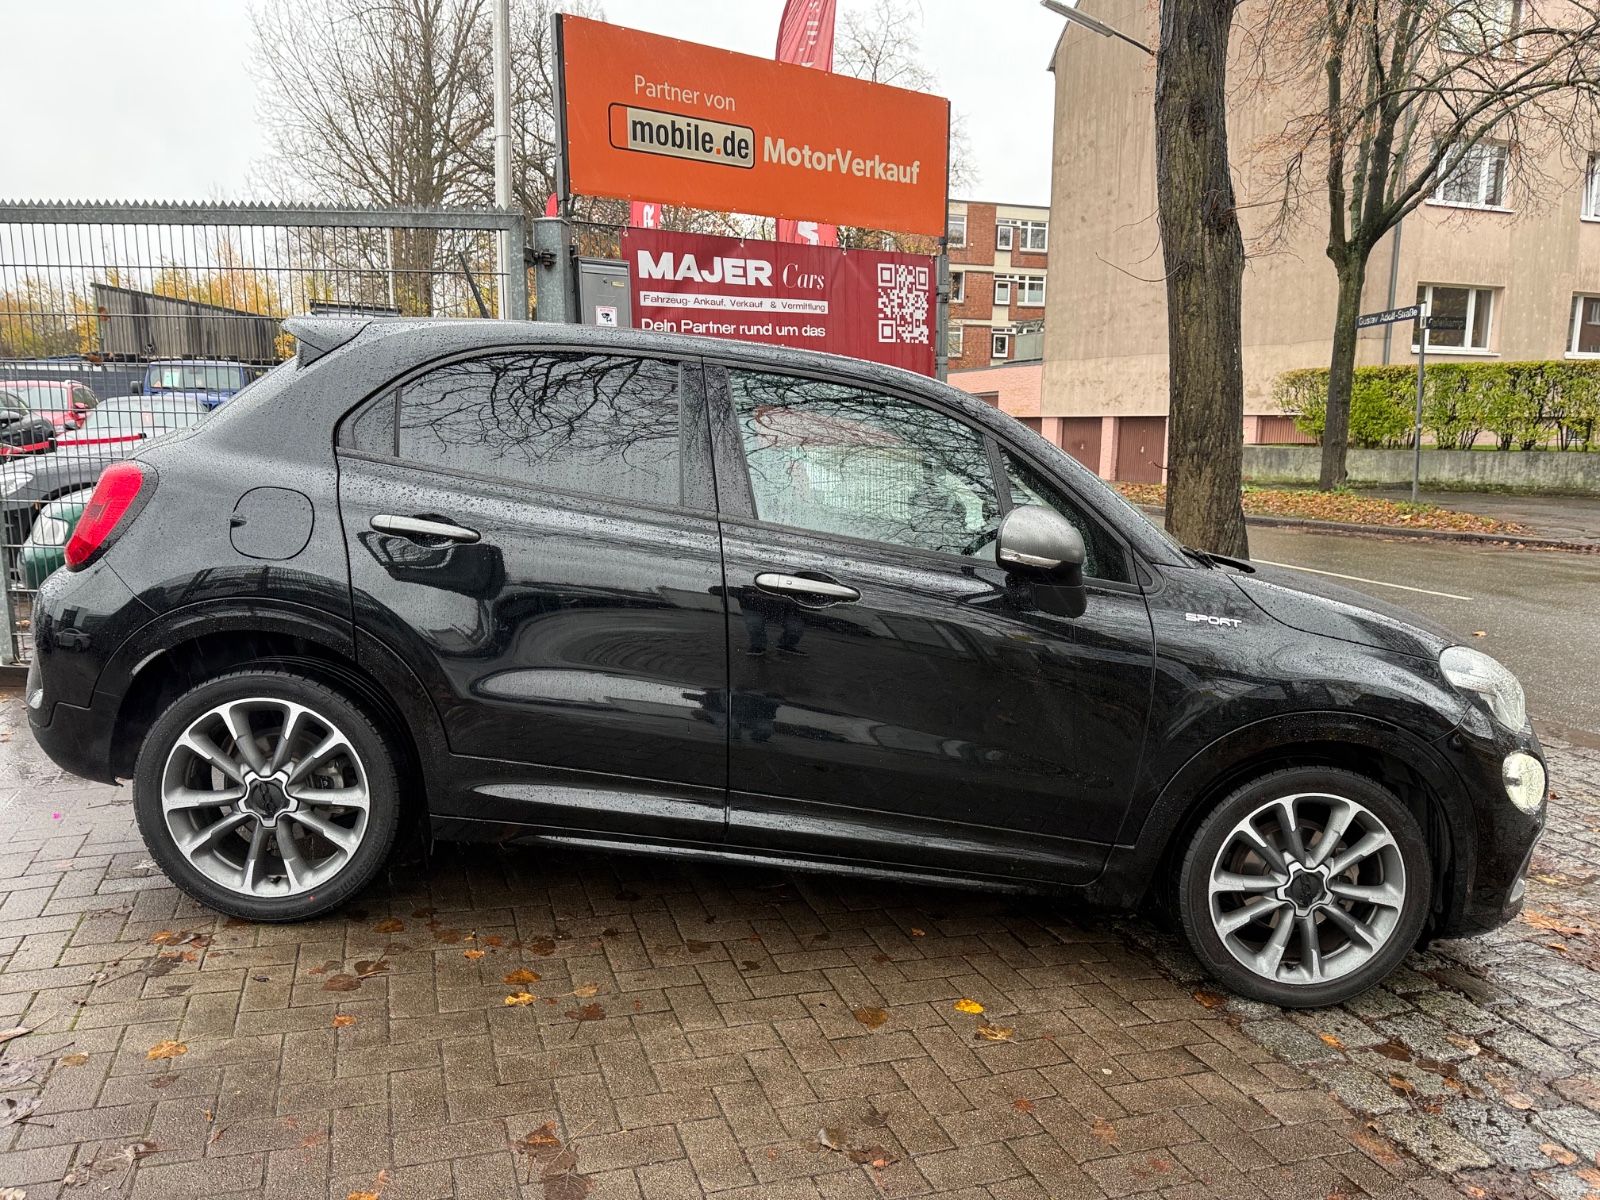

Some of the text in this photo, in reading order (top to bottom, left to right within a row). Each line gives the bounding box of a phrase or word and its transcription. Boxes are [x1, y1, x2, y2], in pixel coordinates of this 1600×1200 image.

[633, 74, 736, 112] Partner von
[631, 118, 921, 185] mobile.de MotorVerkauf
[637, 249, 826, 290] MAJER Cars
[643, 294, 692, 306] Fahrzeug-
[730, 299, 763, 309] Verkauf
[770, 301, 778, 309] &
[781, 301, 827, 312] Vermittlung
[641, 318, 827, 337] Dein Partner rund um das
[1185, 612, 1242, 628] SPORT
